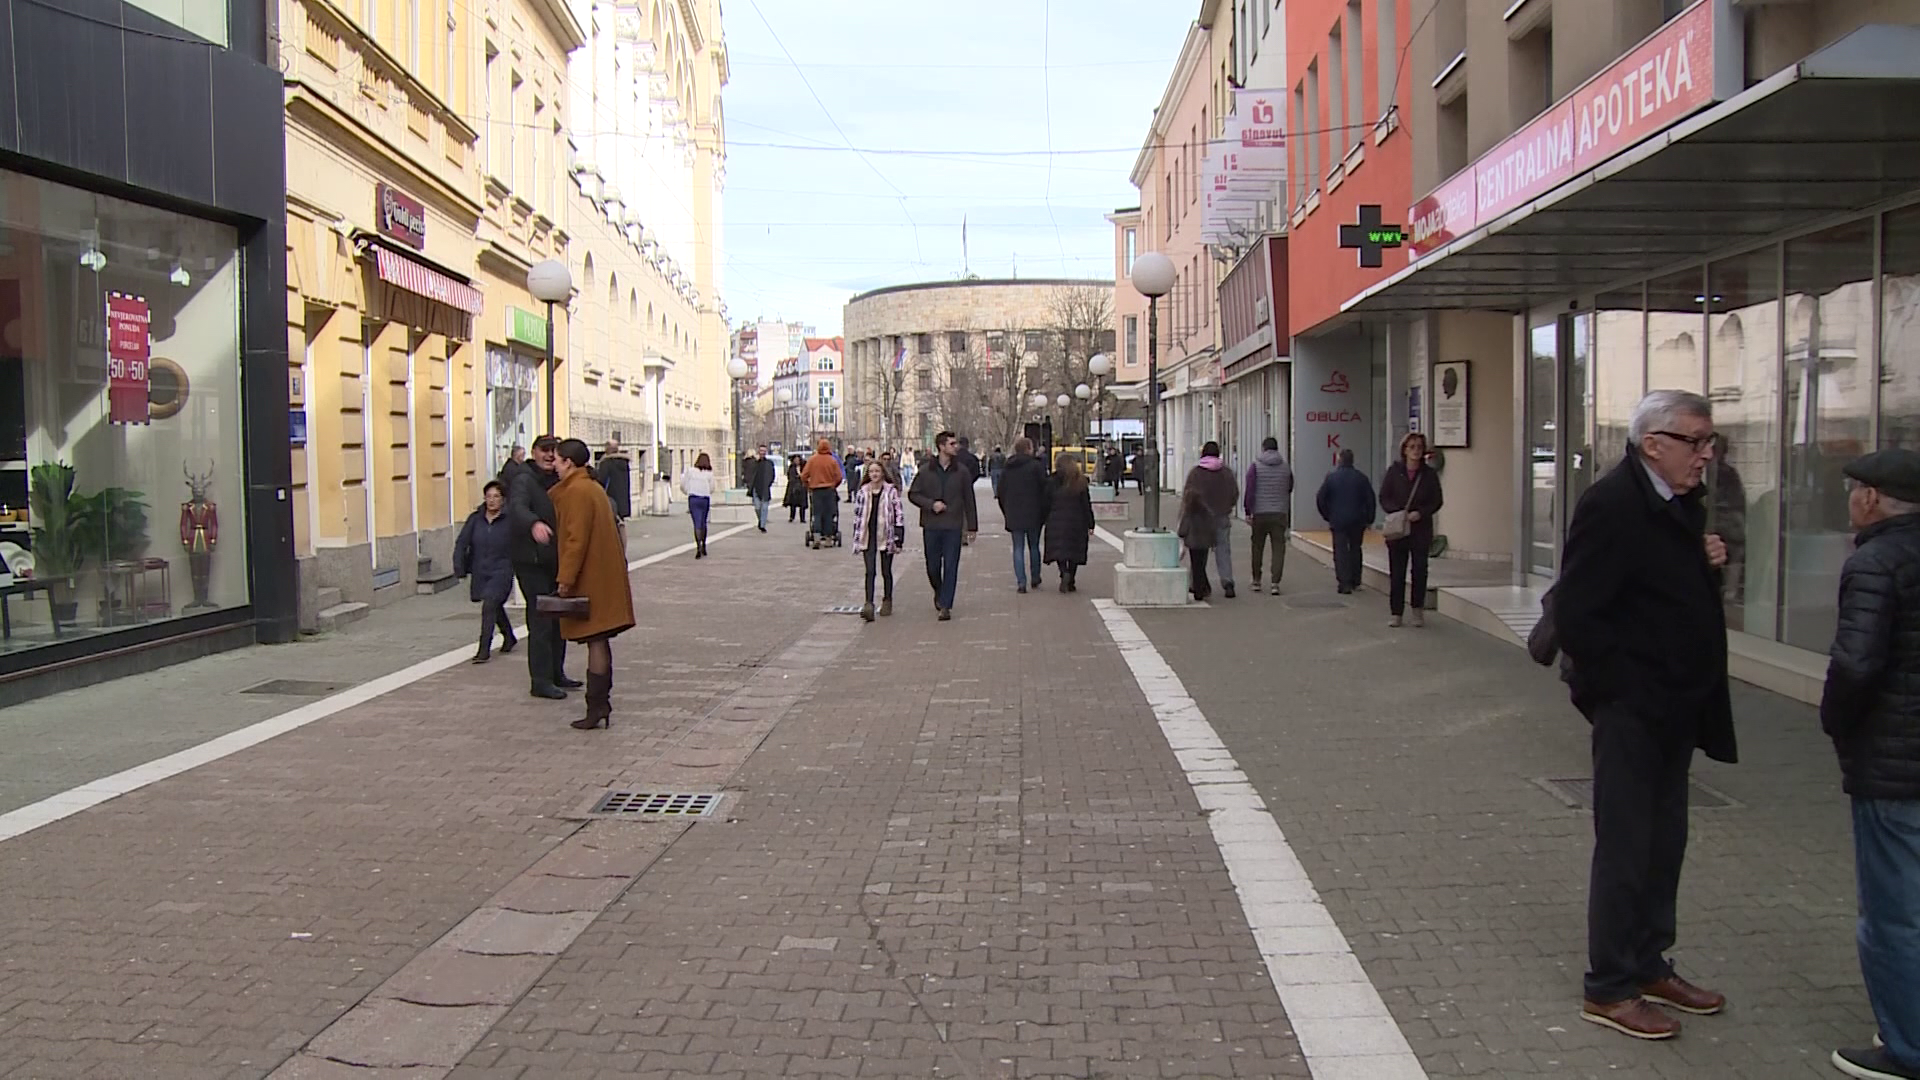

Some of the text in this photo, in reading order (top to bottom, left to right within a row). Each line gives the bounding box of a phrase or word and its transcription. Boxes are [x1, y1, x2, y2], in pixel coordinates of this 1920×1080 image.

[1477, 118, 1573, 212] CENTRALNA
[111, 358, 124, 379] 50
[1306, 409, 1362, 423] OBUĆA
